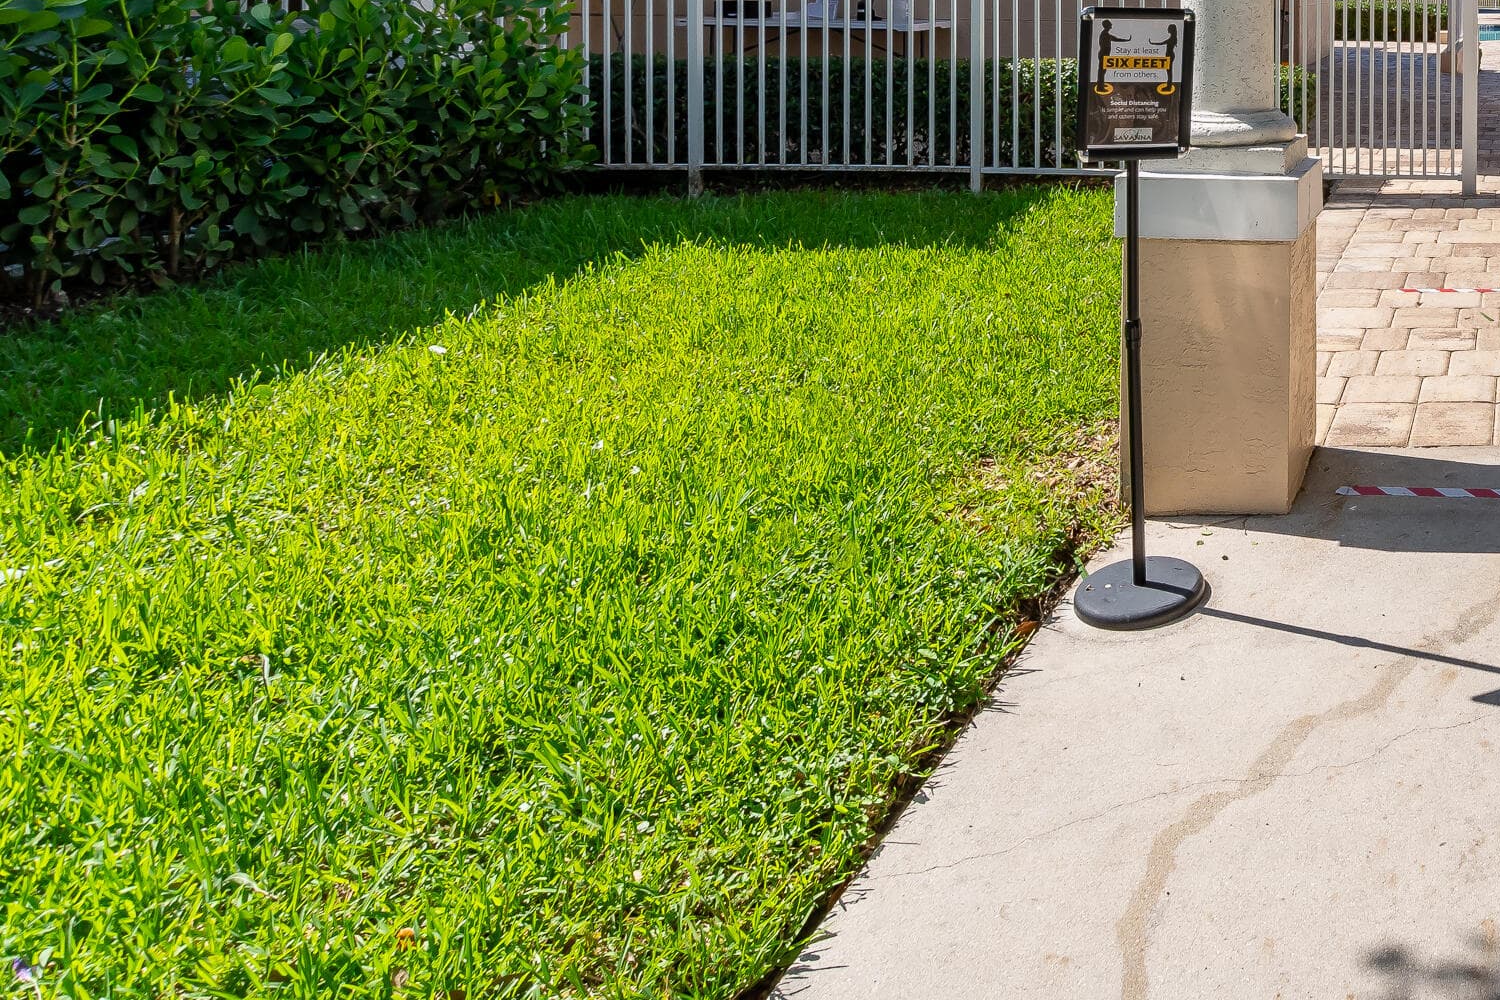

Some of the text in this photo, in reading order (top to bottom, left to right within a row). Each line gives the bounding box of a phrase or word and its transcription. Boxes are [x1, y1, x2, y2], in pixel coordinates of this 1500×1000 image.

[1115, 46, 1132, 56] Stay
[1142, 46, 1160, 54] least
[1106, 58, 1168, 68] SIX FEET
[1113, 71, 1132, 79] from
